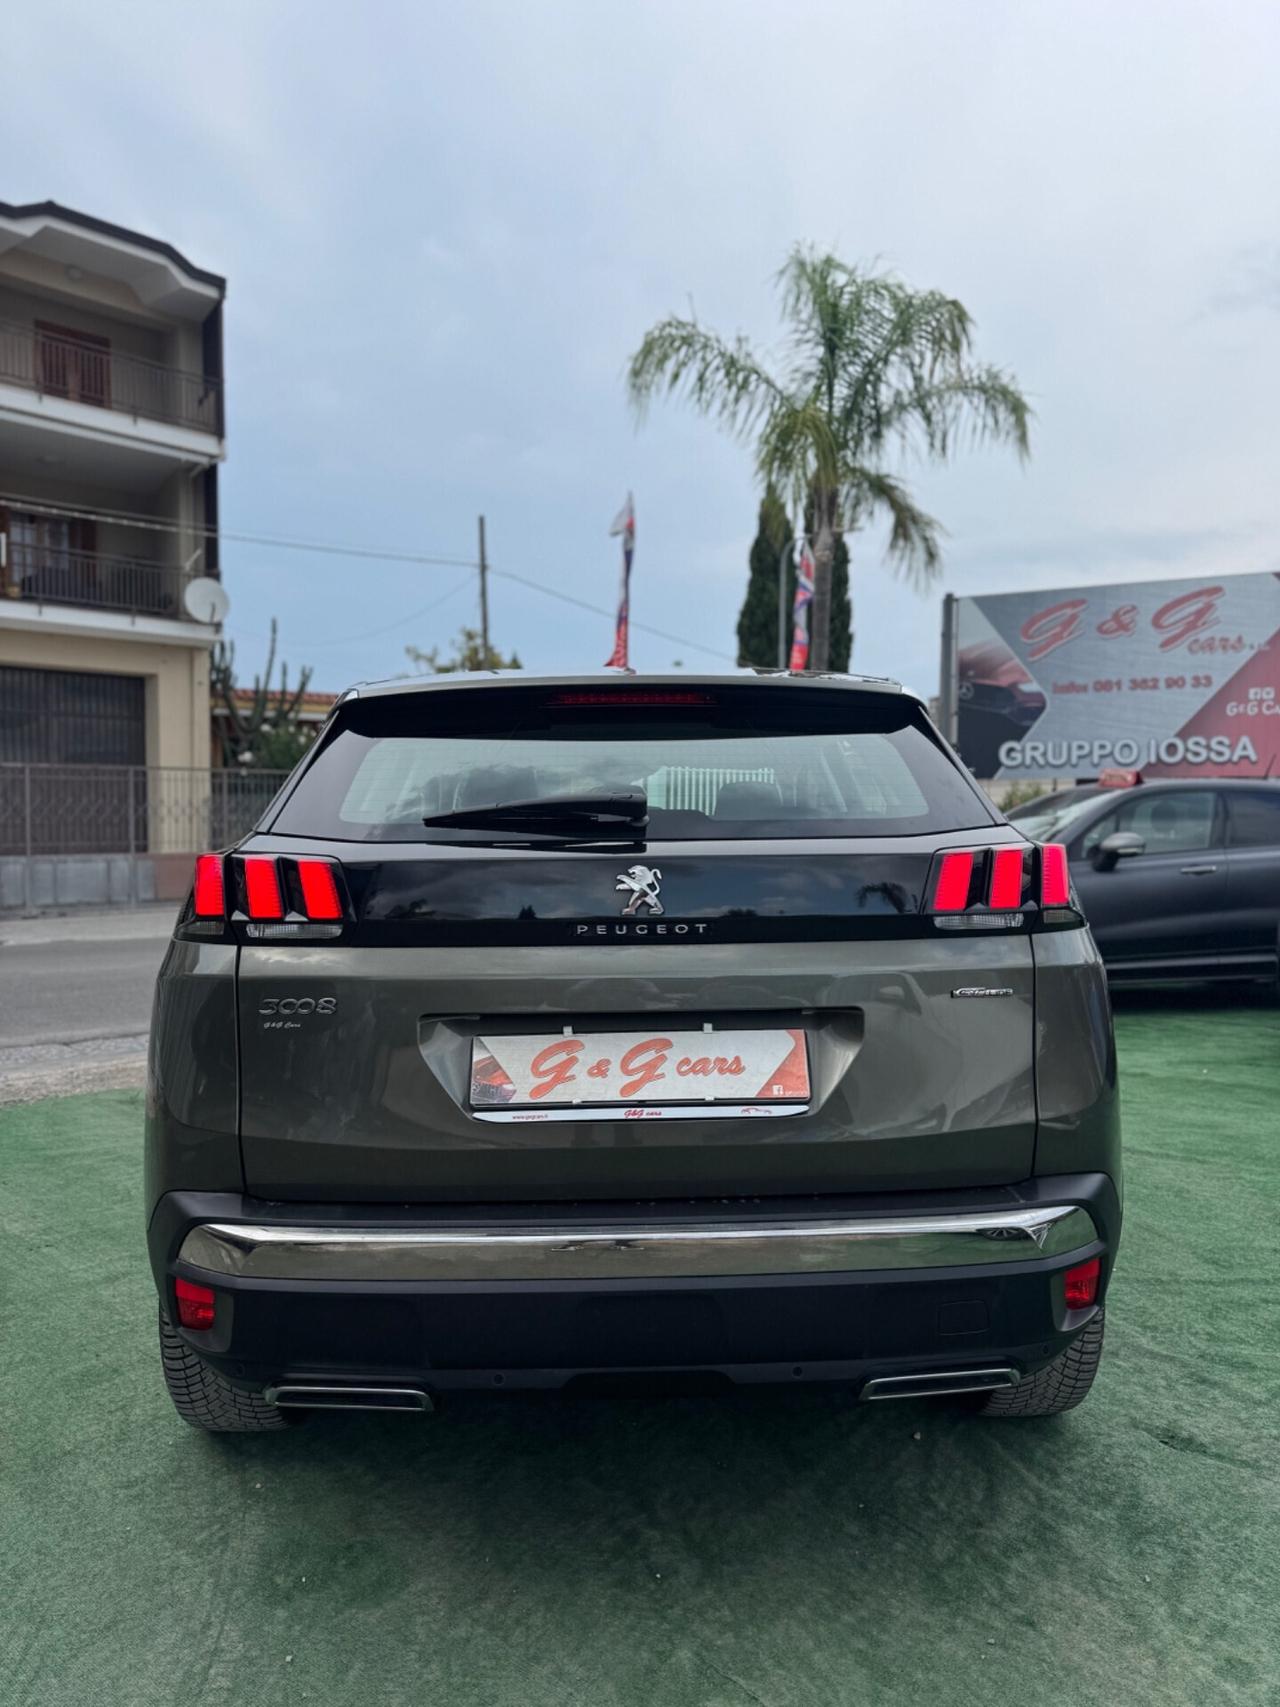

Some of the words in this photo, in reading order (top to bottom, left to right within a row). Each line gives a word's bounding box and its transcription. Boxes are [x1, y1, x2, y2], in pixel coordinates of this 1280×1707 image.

[1020, 599, 1088, 661] G
[1096, 604, 1138, 639] &
[1151, 586, 1225, 651] G
[999, 739, 1140, 768] GRUPPO
[1149, 735, 1258, 765] IOSSA
[576, 923, 708, 936] PEUGEOT
[258, 997, 338, 1016] 3008
[529, 1039, 586, 1100] G
[587, 1057, 612, 1079] &
[619, 1037, 674, 1098] G
[676, 1054, 746, 1078] cars
